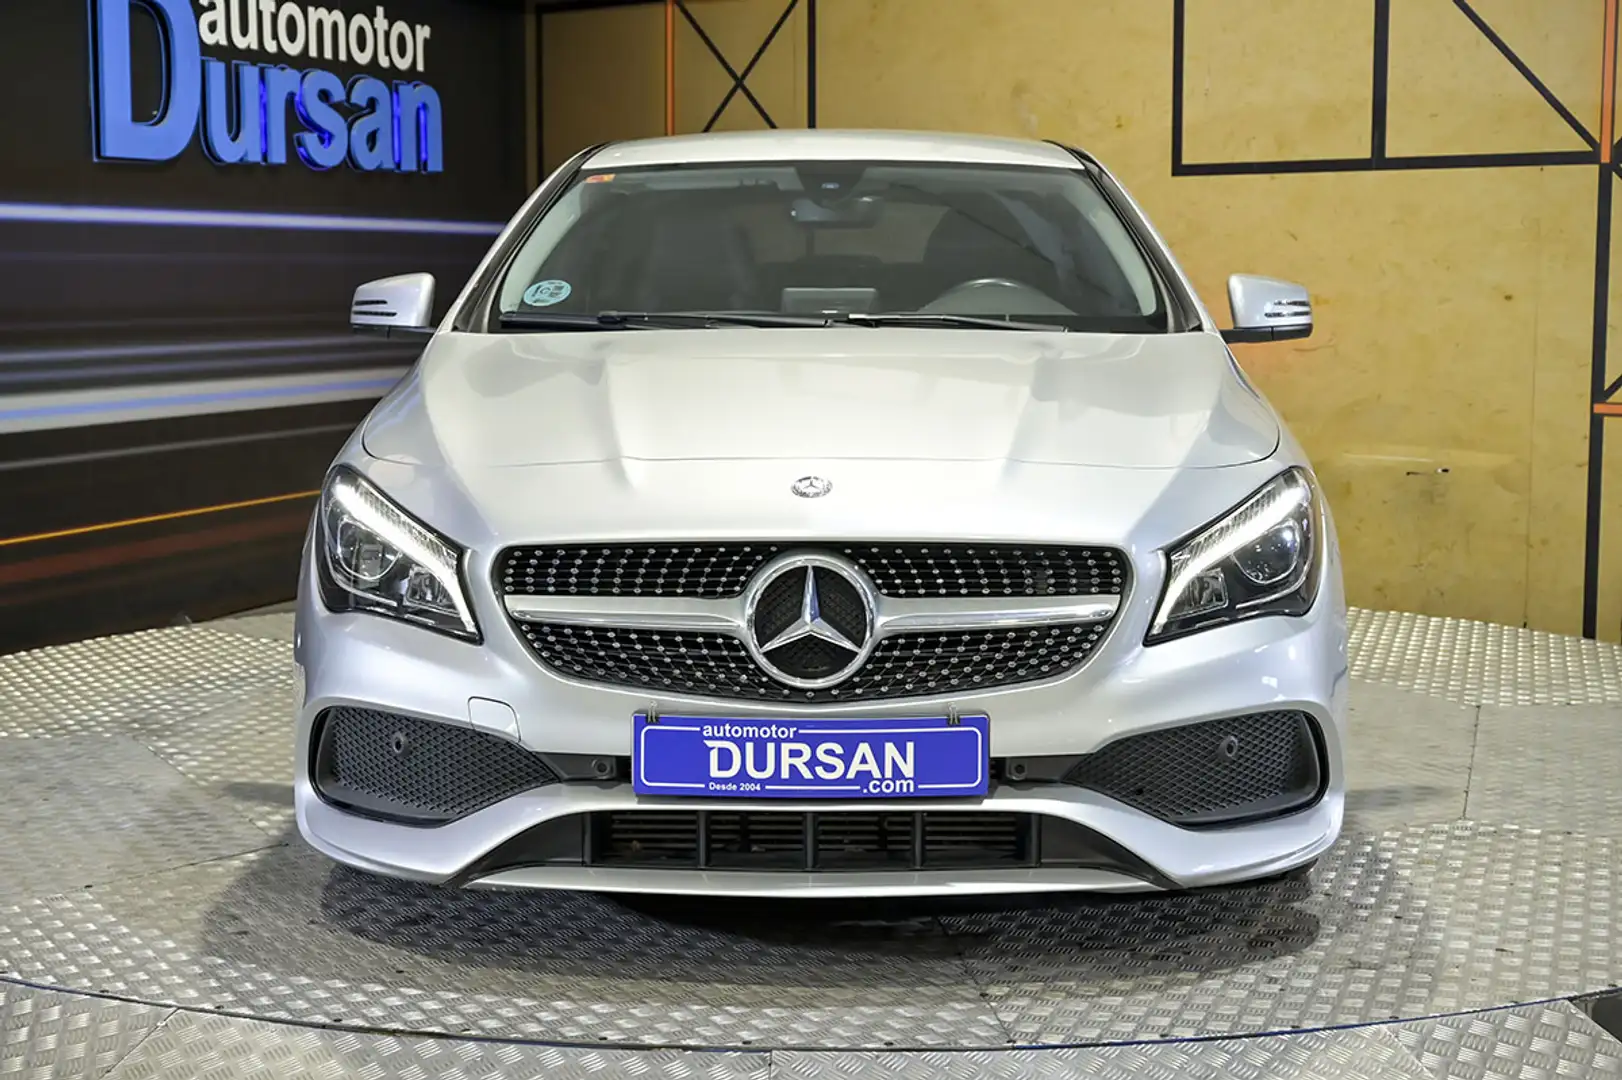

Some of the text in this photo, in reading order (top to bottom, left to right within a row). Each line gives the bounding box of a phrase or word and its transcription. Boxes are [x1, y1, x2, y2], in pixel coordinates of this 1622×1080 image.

[198, 0, 431, 72] automotor
[88, 0, 443, 174] Dursan
[702, 723, 797, 739] automotor
[703, 739, 915, 780] DURSAN
[708, 781, 761, 792] Desde 2004
[862, 778, 915, 794] .com
